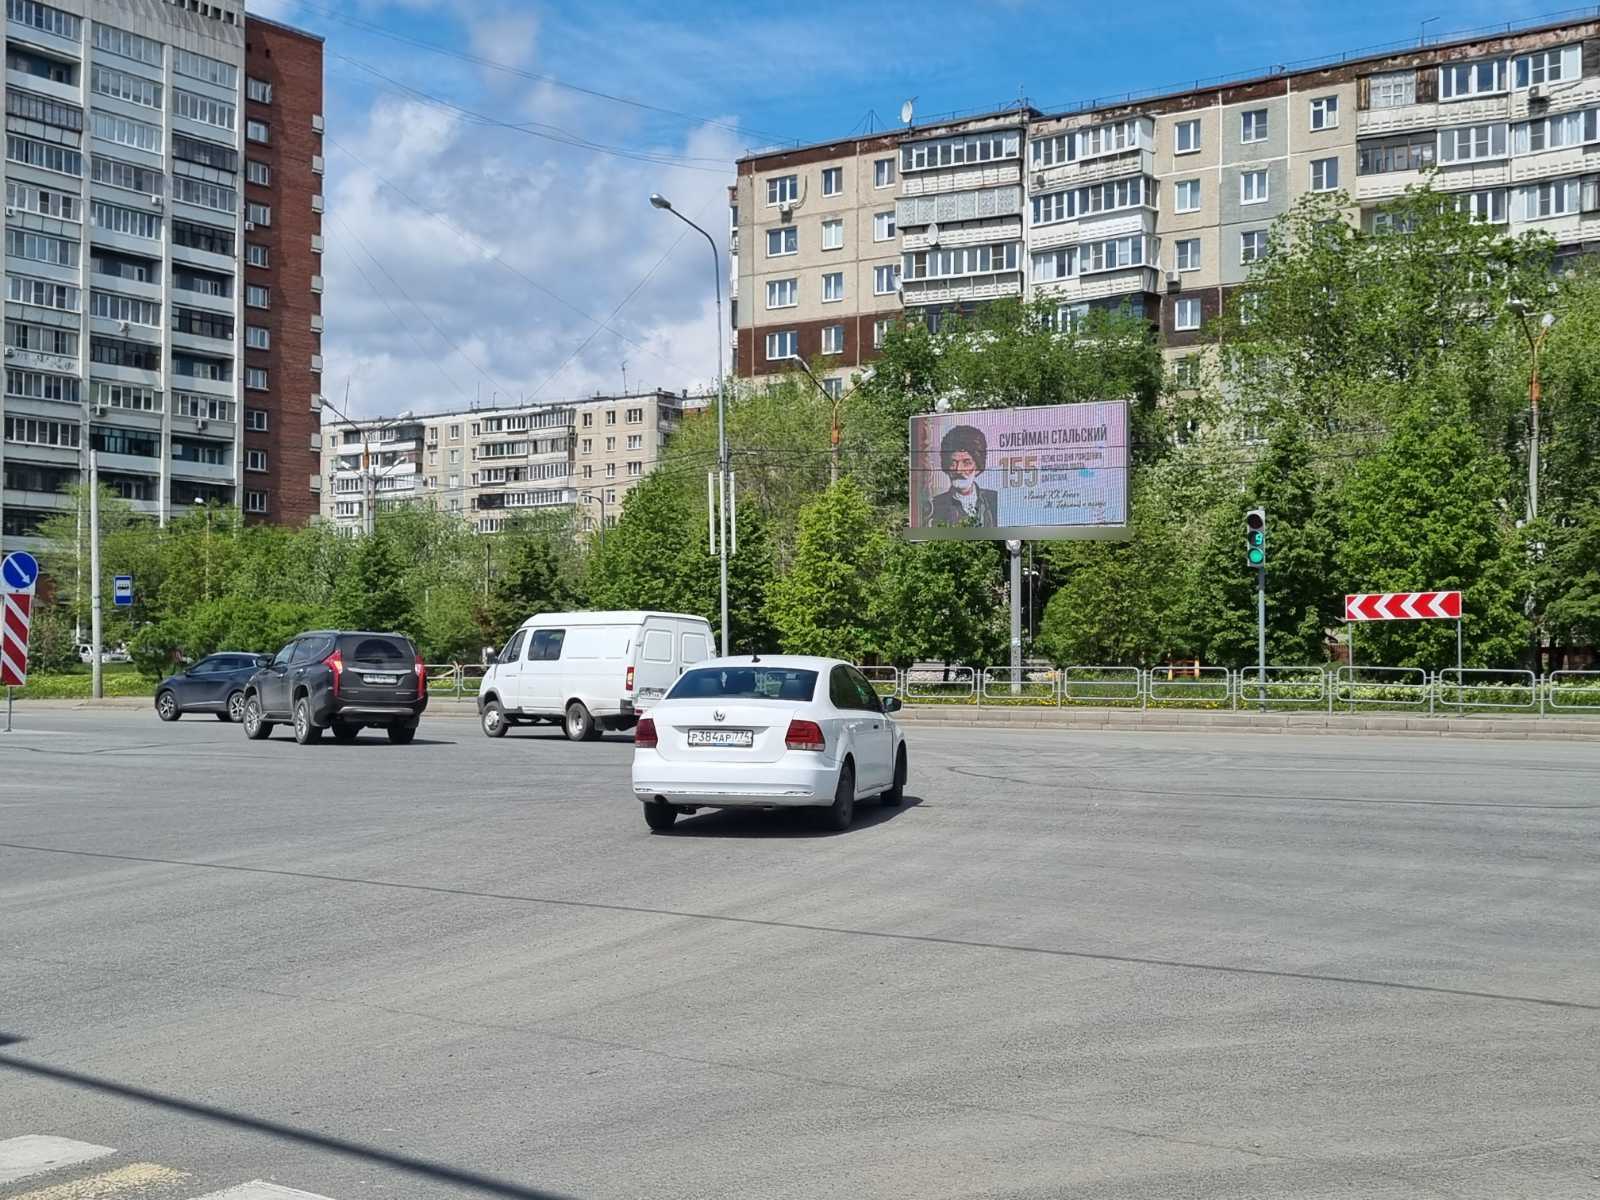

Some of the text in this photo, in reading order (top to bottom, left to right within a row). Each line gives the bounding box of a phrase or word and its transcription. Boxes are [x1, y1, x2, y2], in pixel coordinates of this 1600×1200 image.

[999, 424, 1107, 448] СУЛЕЙМАН СТАЛЬСКИЙ
[999, 455, 1038, 488] 155
[691, 731, 731, 743] Р384АР
